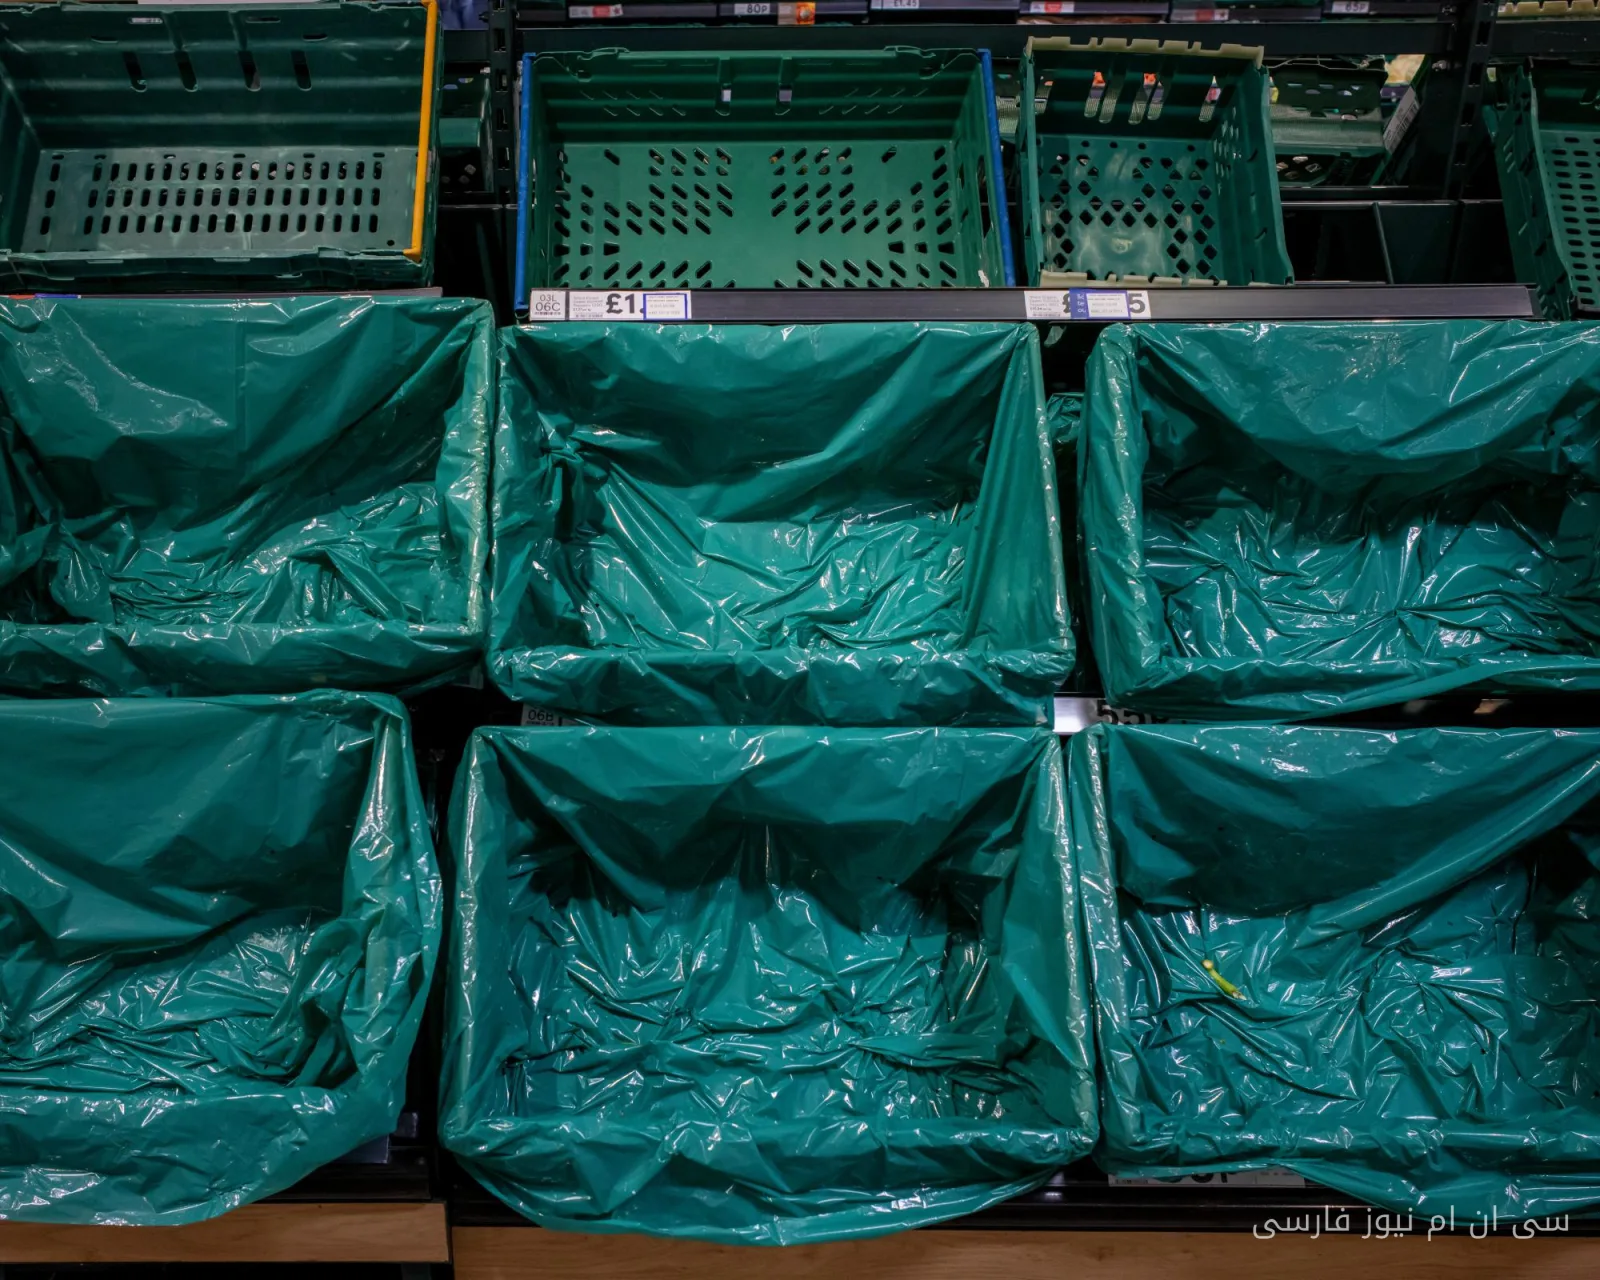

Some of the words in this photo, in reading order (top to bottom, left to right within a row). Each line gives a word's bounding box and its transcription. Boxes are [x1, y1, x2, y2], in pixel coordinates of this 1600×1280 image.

[539, 293, 557, 302] 03L
[535, 301, 561, 312] 06C
[528, 709, 554, 722] 06B
